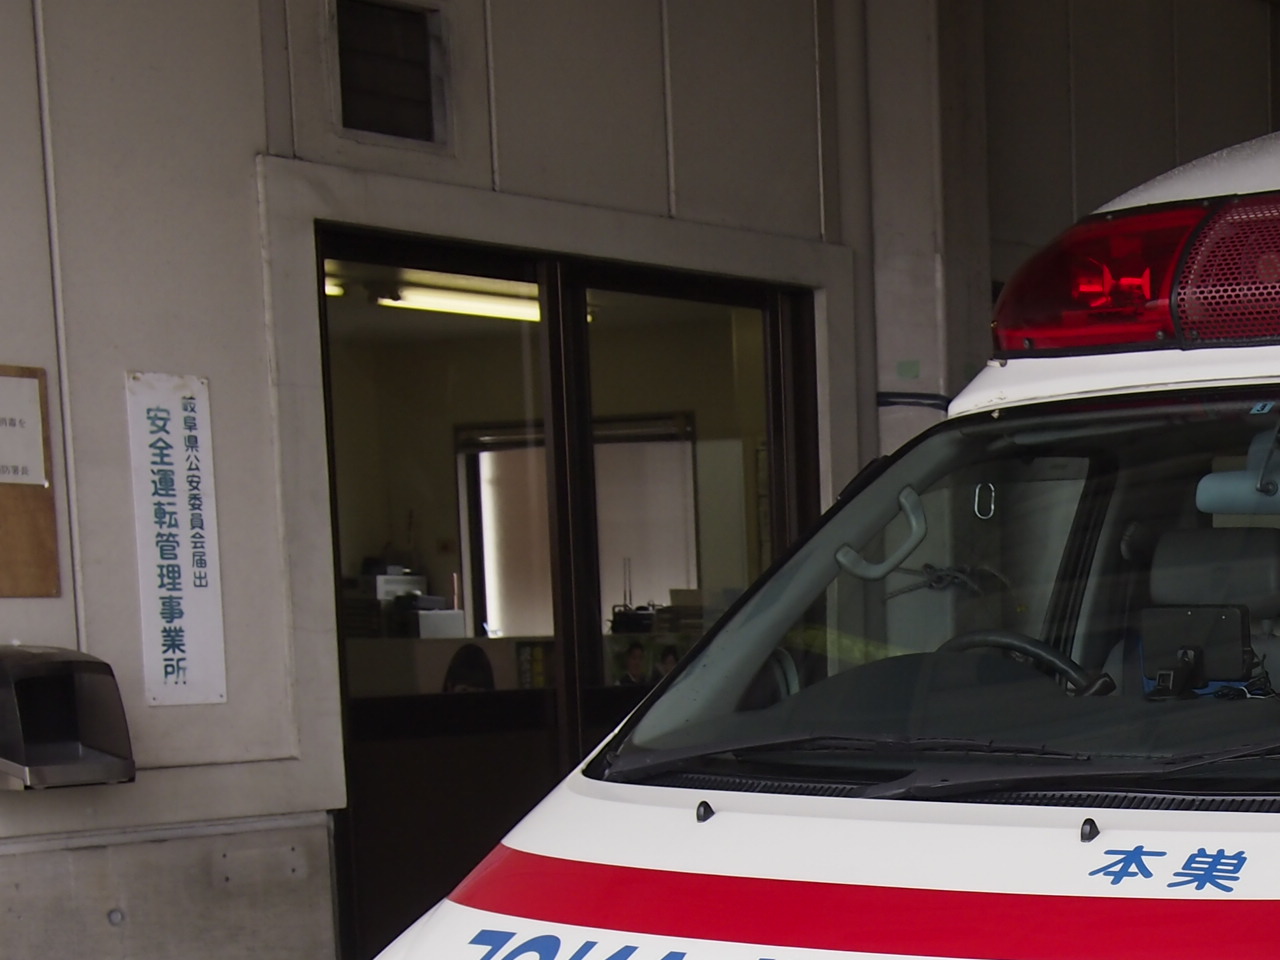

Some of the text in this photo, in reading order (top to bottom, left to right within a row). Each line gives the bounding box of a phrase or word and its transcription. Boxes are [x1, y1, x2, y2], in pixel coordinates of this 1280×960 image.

[146, 406, 187, 685] 安全運転管理事業所
[181, 395, 209, 589] 岐阜県公安委員会届出
[1088, 845, 1248, 893] 本巣
